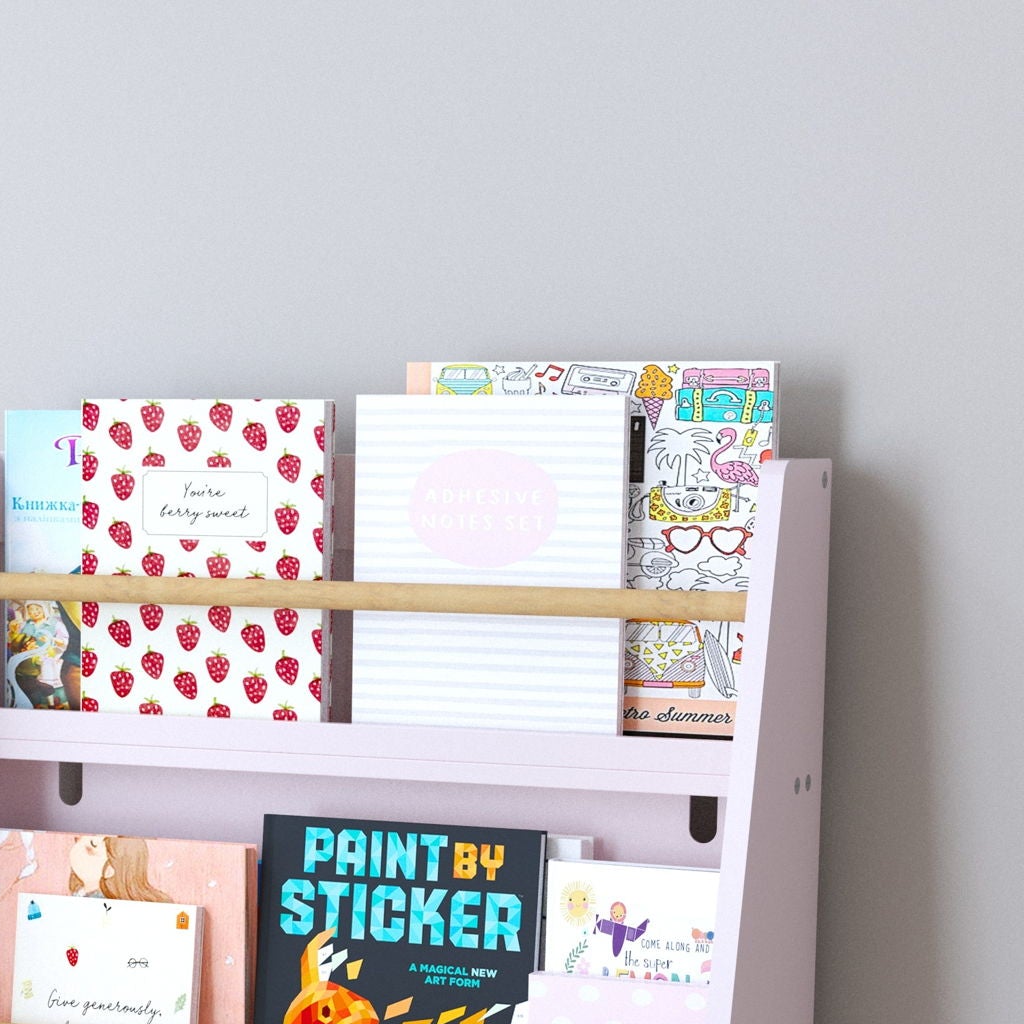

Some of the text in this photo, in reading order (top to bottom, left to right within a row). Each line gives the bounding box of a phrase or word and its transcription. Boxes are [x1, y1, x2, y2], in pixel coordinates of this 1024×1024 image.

[184, 480, 226, 499] You're
[424, 487, 545, 506] ADHESIVE
[160, 503, 251, 526] berry sweet
[420, 513, 546, 533] NOTES SET
[655, 706, 733, 724] Summer
[303, 826, 505, 882] PAINT BY
[279, 878, 522, 952] STICKER
[640, 938, 710, 954] COME ALONG AND
[624, 949, 674, 973] the super
[408, 963, 498, 979] A MAGICAL NEW
[424, 975, 481, 989] ART FORM
[47, 988, 80, 1009] Give
